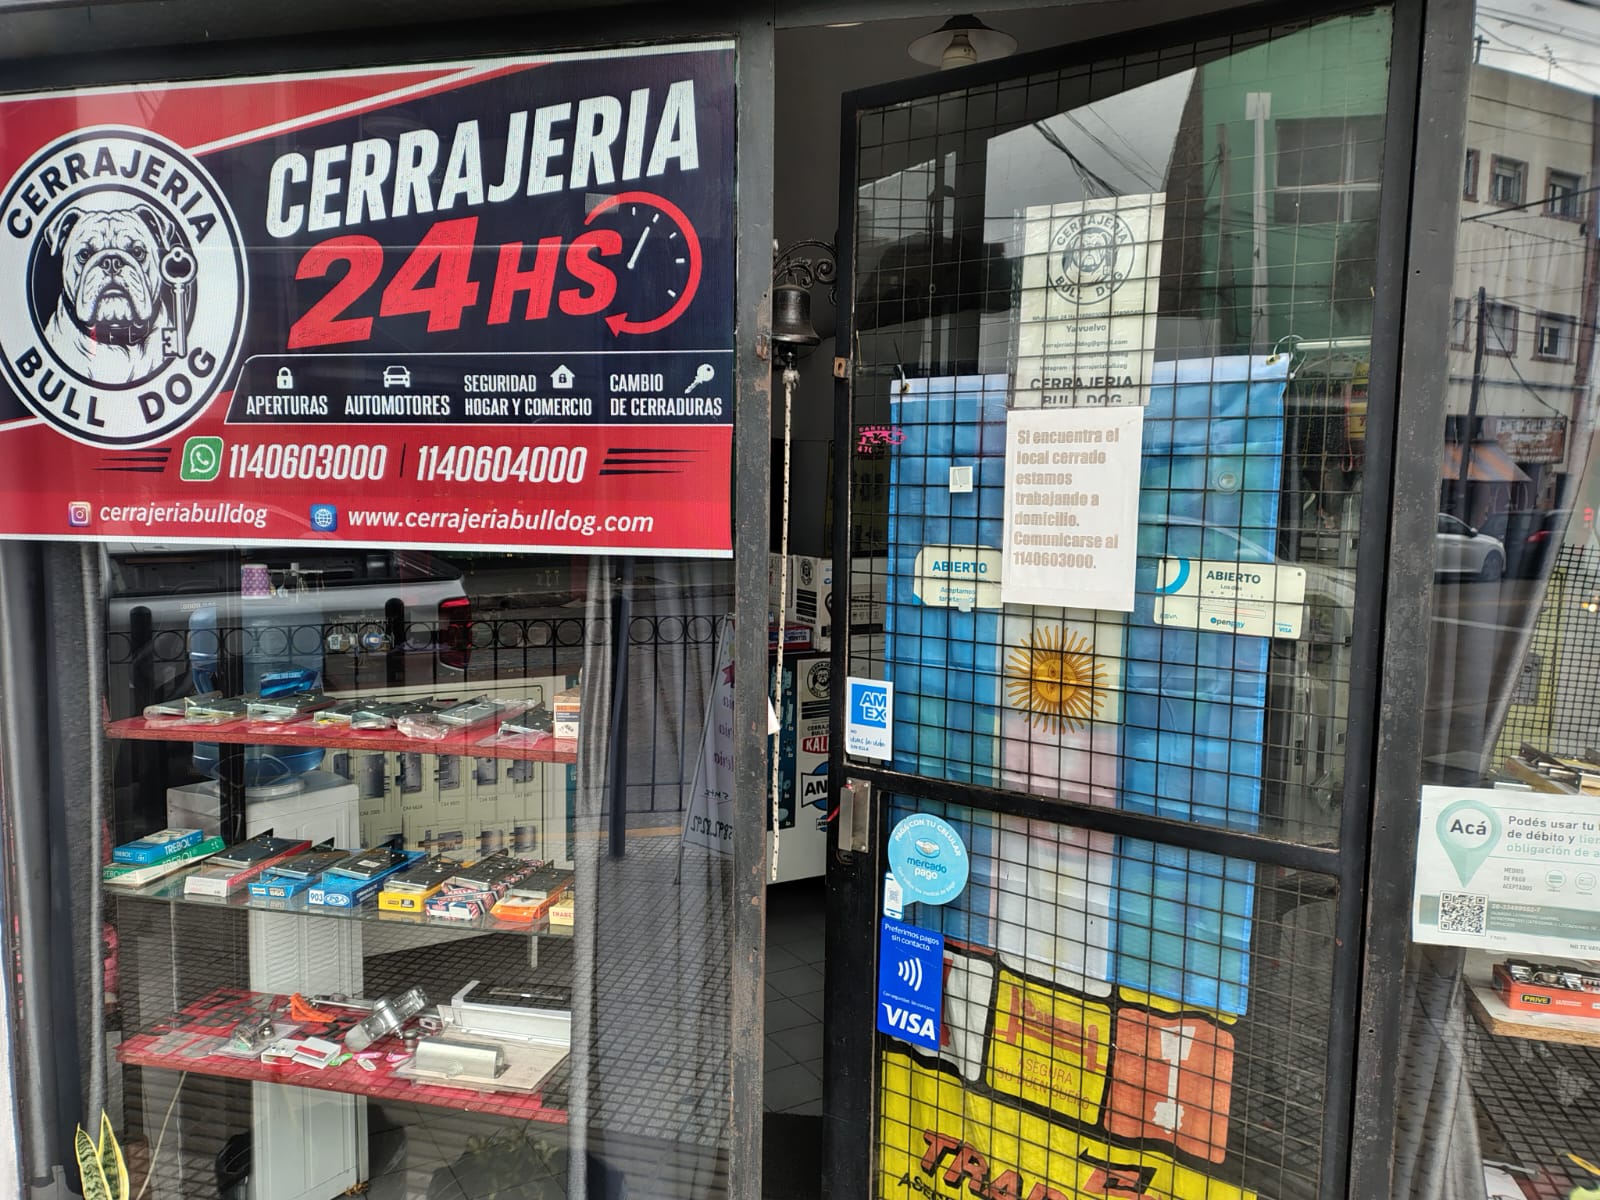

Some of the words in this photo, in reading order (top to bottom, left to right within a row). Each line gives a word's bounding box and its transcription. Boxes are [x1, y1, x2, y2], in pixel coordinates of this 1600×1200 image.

[265, 79, 699, 239] CERRAJERIA
[7, 146, 217, 243] CERRAJERIA
[15, 346, 105, 428] BULL
[138, 346, 217, 424] DOG
[464, 374, 537, 393] SEGURIDAD
[610, 373, 663, 393] CAMBIO
[246, 395, 328, 416] APERTURAS
[344, 394, 450, 416] AUTOMOTORES
[465, 398, 508, 416] HOGAR
[510, 398, 520, 416] Y
[524, 398, 592, 417] COMERCIO
[610, 398, 628, 416] DE
[630, 398, 722, 416] CERRADURAS
[1017, 430, 1030, 444] Si
[1033, 428, 1102, 444] encuentra
[1105, 427, 1119, 442] el
[229, 444, 388, 481] 1140603000
[417, 445, 588, 484] 1140604000
[1016, 450, 1049, 465] local
[1052, 449, 1106, 465] cerrado
[1016, 472, 1073, 485] estamos
[1016, 491, 1089, 507] trabajando
[1090, 494, 1099, 506] a
[99, 502, 268, 529] cerrajeriabulldog
[348, 509, 654, 536] www.cerrajeriabulldog.com
[1014, 511, 1080, 527] domicilio.
[1014, 531, 1102, 549] Comunicarse
[1105, 534, 1119, 549] al
[932, 561, 988, 574] ABIERTO
[1206, 570, 1261, 584] ABIERTO
[1450, 820, 1487, 836] Acá
[1508, 815, 1547, 828] Podés
[1550, 820, 1578, 830] usar
[1582, 822, 1594, 831] tu
[1507, 829, 1522, 839] de
[1526, 830, 1565, 842] débito
[1568, 834, 1575, 844] y
[164, 839, 191, 855] TREBOL
[1506, 843, 1571, 858] obligación
[1574, 847, 1589, 857] de
[906, 856, 947, 874] mercado
[914, 867, 938, 880] pago
[884, 923, 920, 939] Preferimos
[919, 934, 940, 946] pagos
[891, 934, 901, 942] sin
[881, 1002, 936, 1041] VISA
